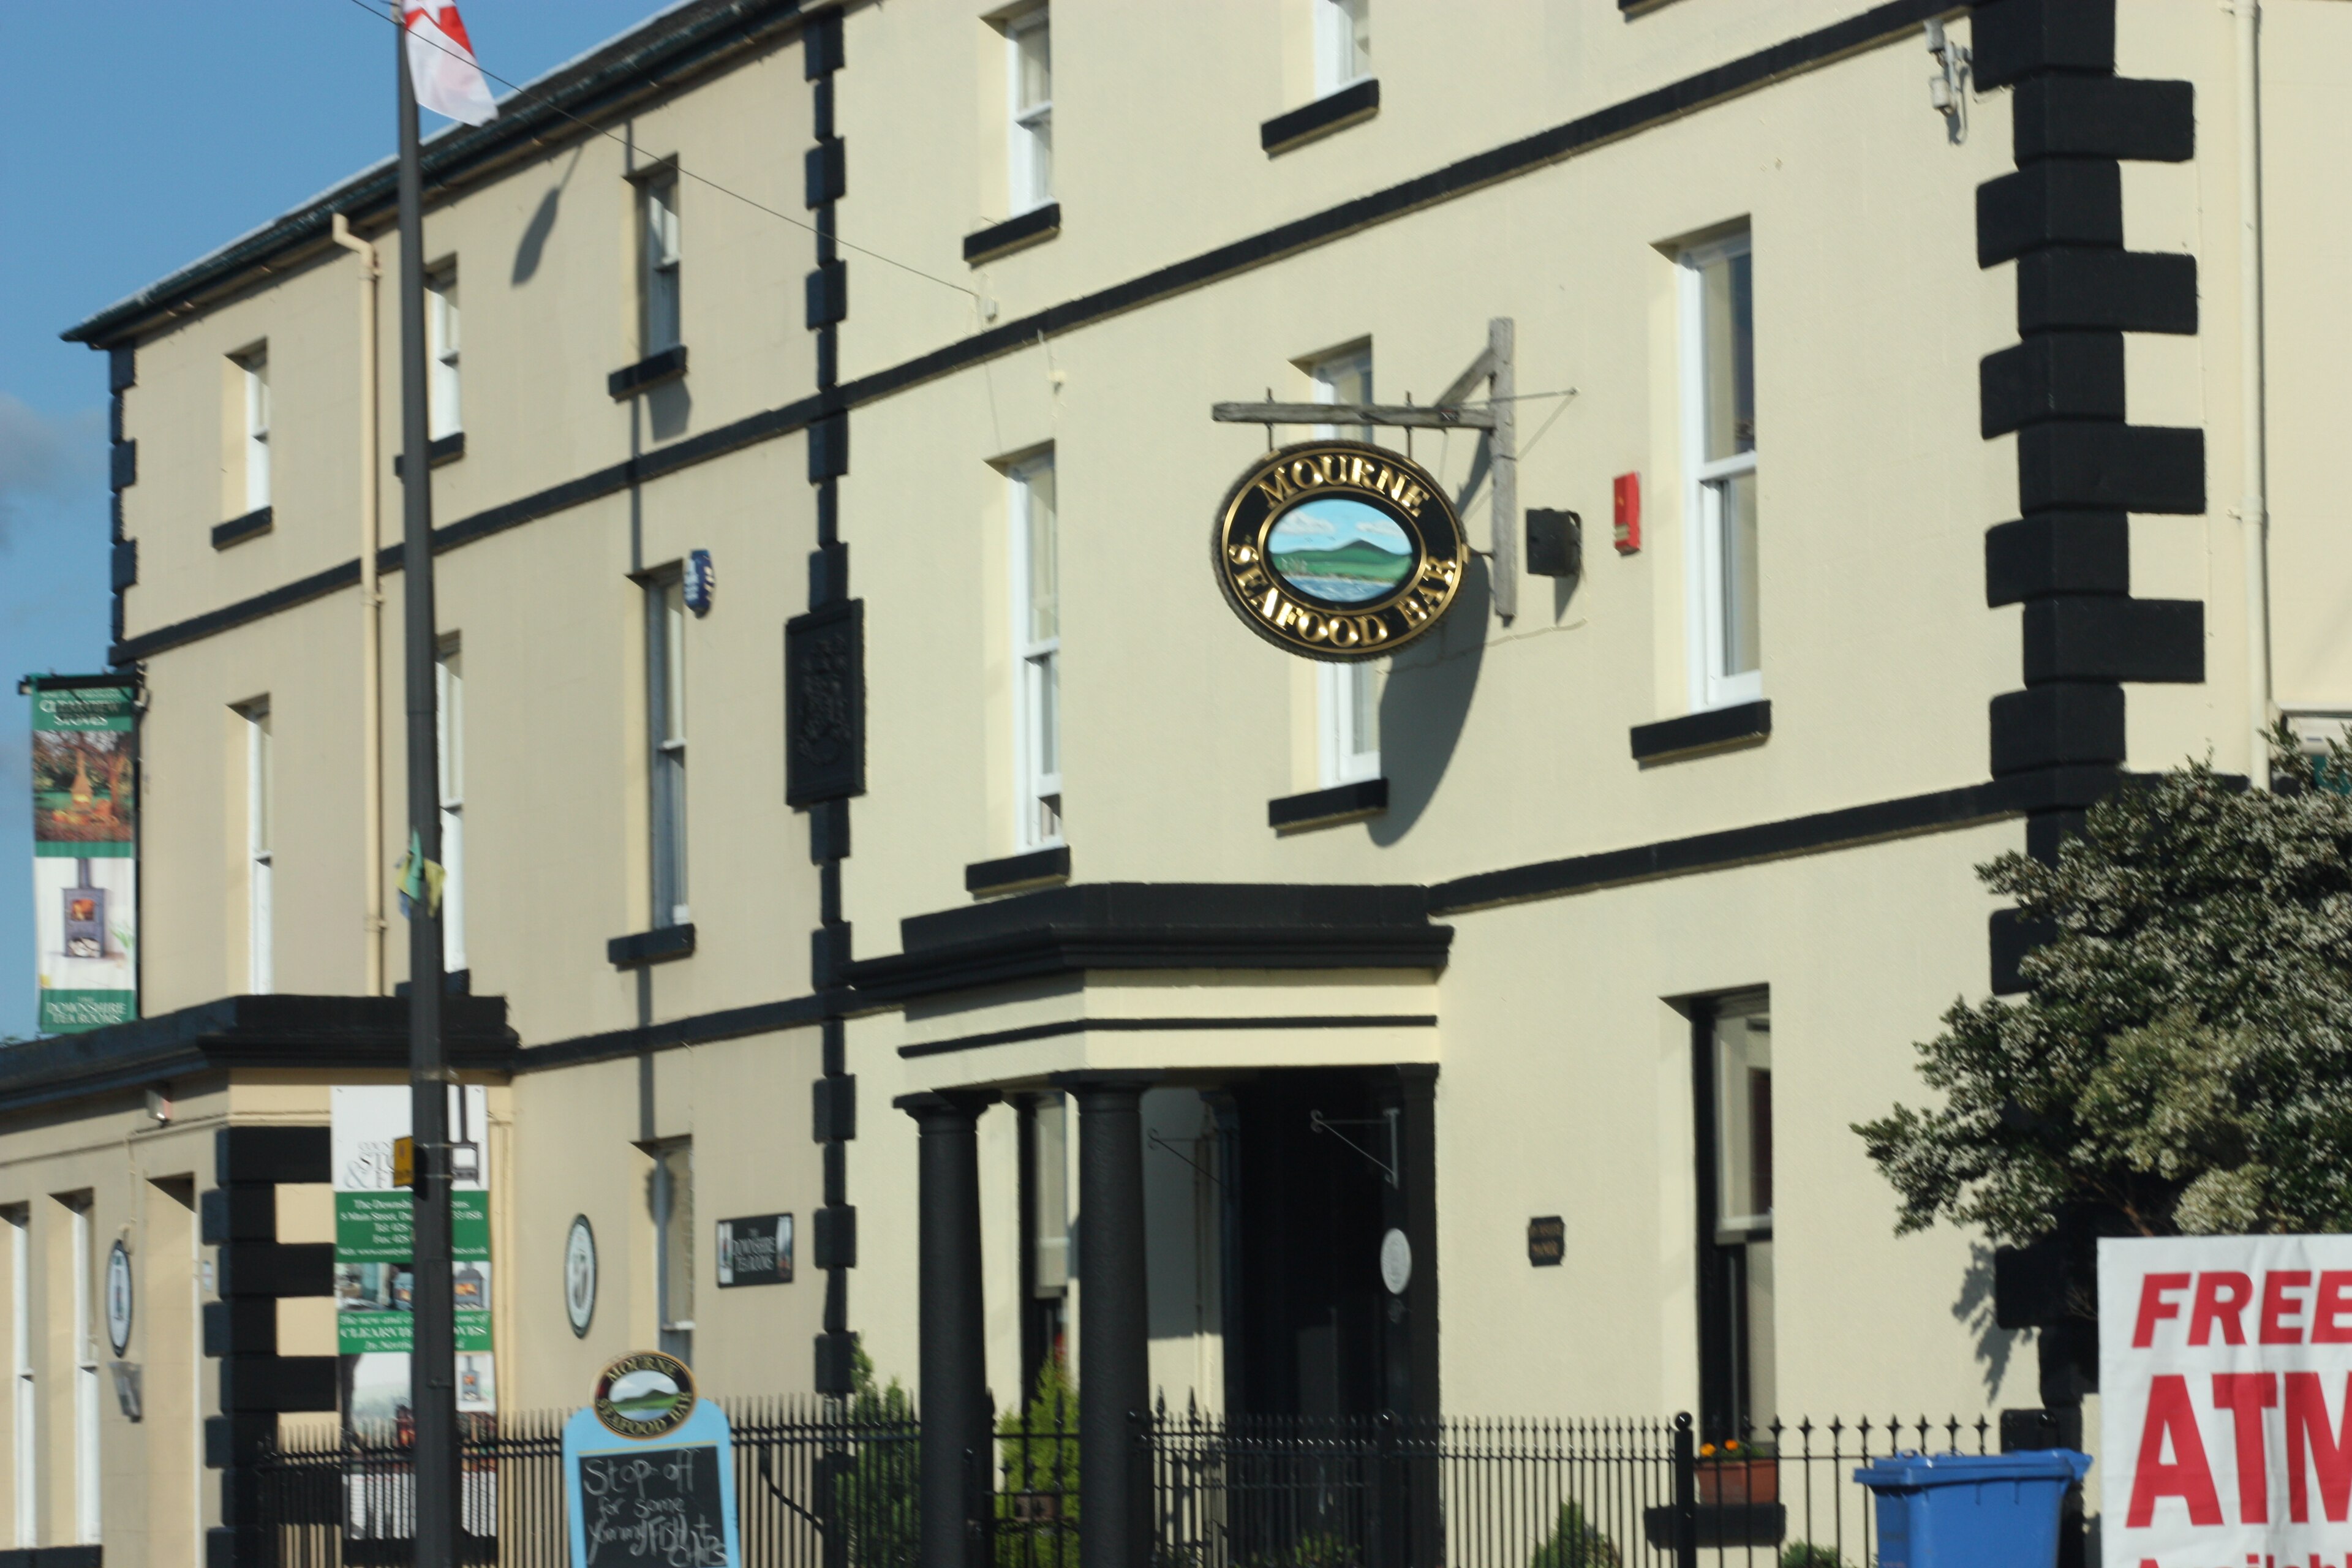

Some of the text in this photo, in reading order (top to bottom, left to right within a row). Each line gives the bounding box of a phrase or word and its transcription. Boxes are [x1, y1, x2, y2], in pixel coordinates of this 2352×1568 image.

[1256, 455, 1430, 518] MOURNE
[1229, 543, 1457, 647] SEAFOOD BAR
[2132, 1270, 2352, 1349] FREE
[606, 1356, 679, 1382] MOURNE
[597, 1398, 666, 1434] SEAFOOD
[584, 1448, 700, 1499] Stop off
[2125, 1370, 2352, 1528] ATM
[598, 1496, 626, 1523] for
